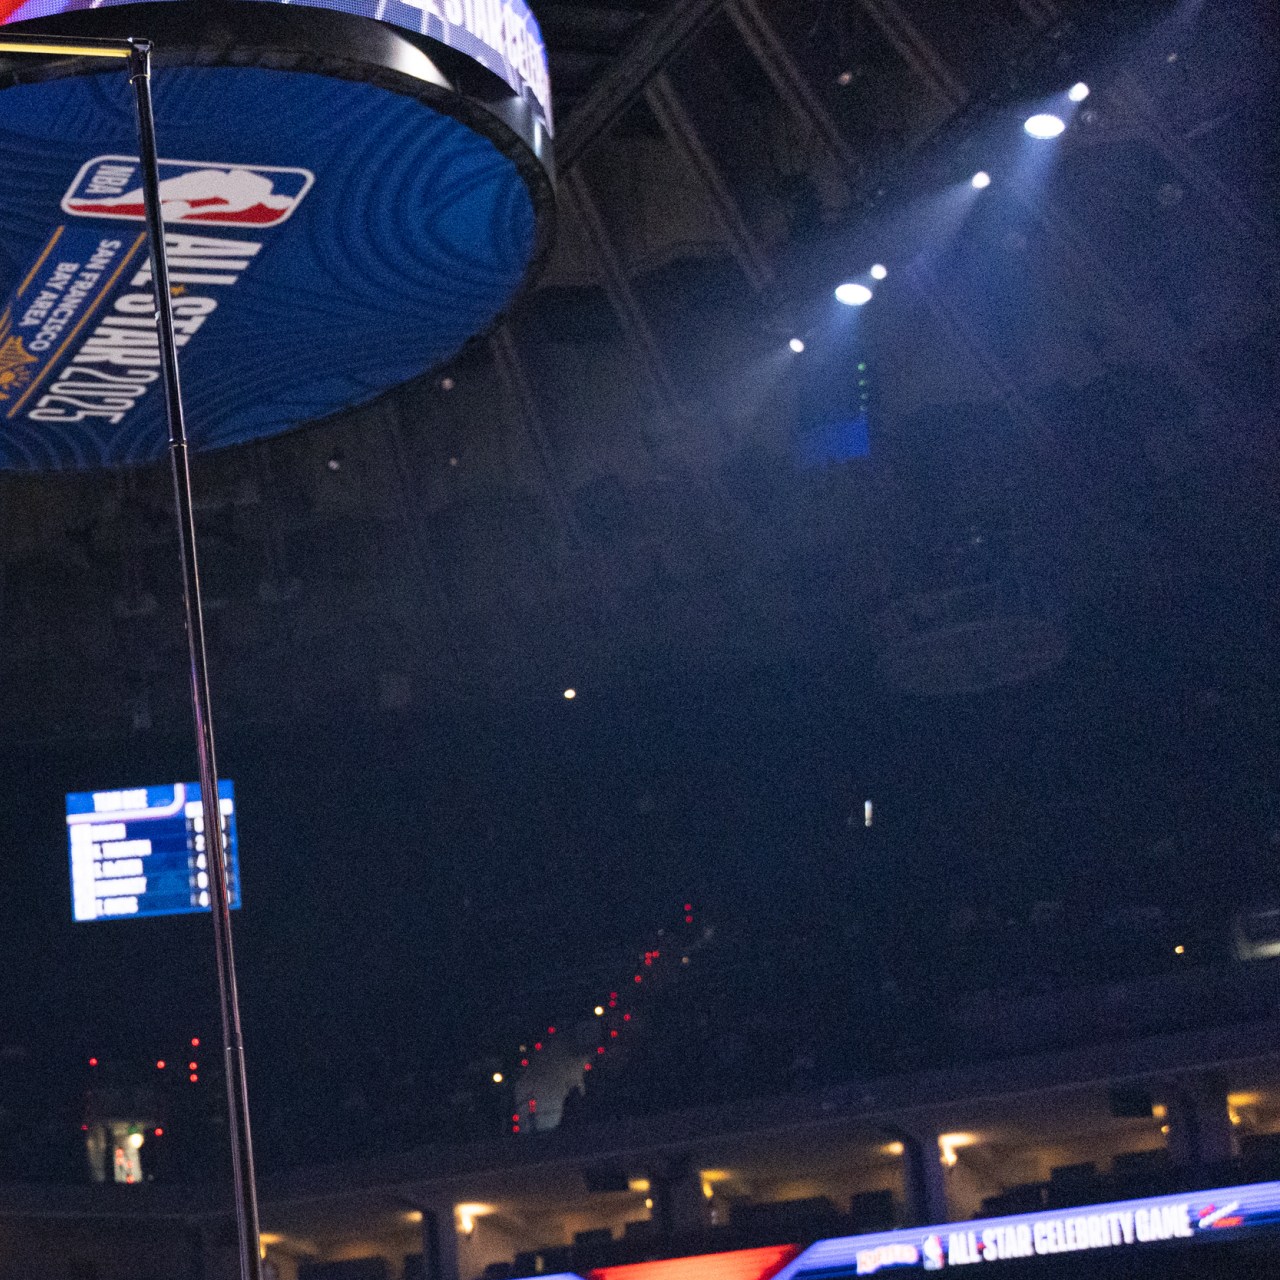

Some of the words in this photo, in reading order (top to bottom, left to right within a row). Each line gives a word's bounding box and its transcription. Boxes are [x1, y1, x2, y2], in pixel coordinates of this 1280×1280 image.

[85, 164, 136, 194] NBA
[85, 239, 122, 271] SAN
[45, 262, 79, 291] BAY
[18, 290, 59, 327] AREA
[28, 271, 101, 351] FRANCISCO
[28, 365, 160, 425] 2025
[1033, 1211, 1137, 1255] CELEBRITY
[1135, 1203, 1194, 1243] GAME
